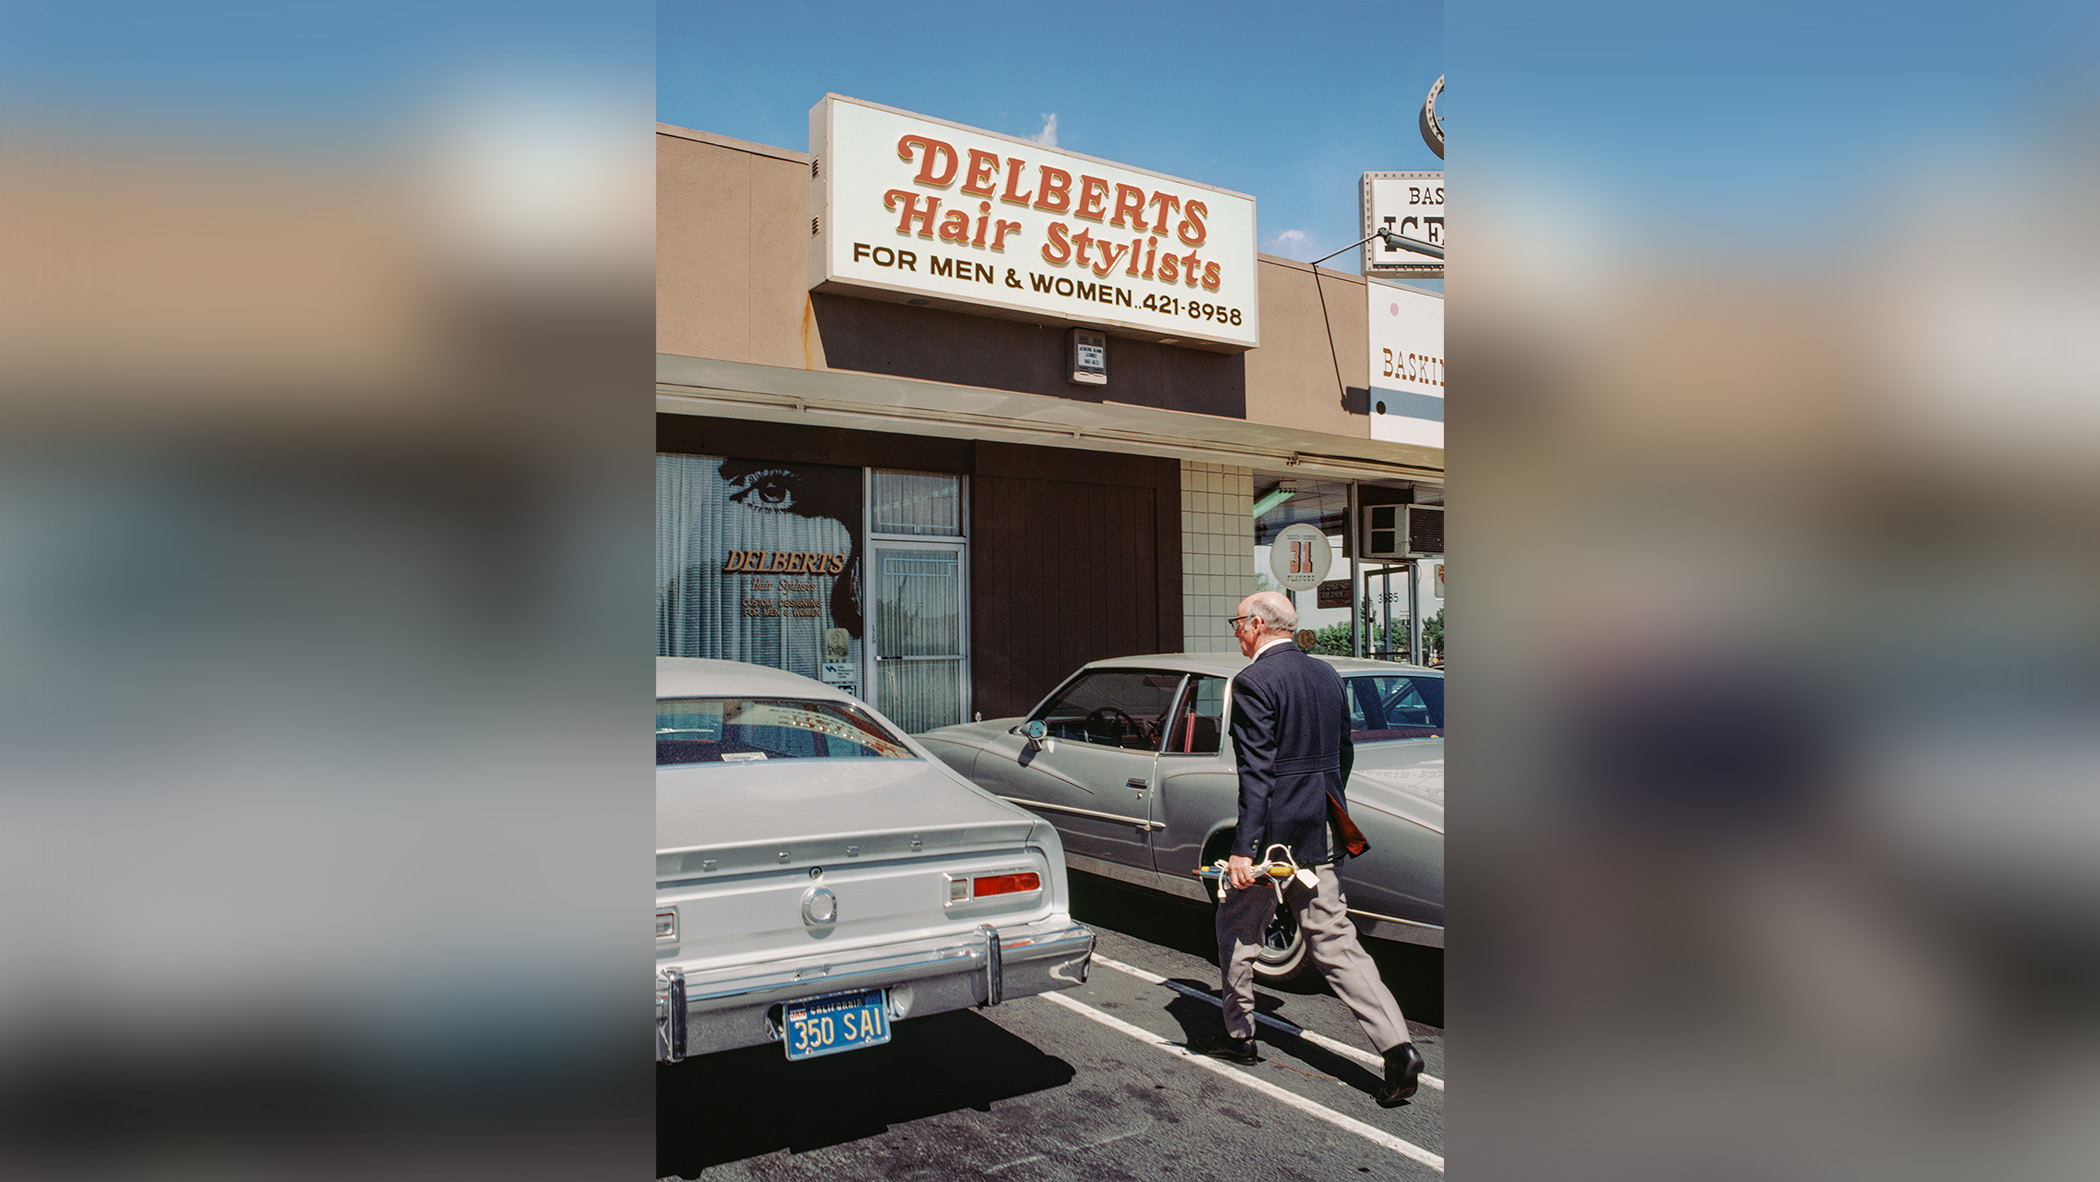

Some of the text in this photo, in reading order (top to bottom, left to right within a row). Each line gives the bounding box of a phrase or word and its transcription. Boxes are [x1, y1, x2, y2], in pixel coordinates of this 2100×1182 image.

[896, 134, 1209, 246] DELBERTS
[883, 188, 1222, 290] Hair Stylists
[853, 242, 918, 272] FOR
[930, 257, 994, 285] MEN
[1005, 268, 1024, 290] &
[723, 550, 845, 575] DELBERTS
[1289, 541, 1313, 573] 31
[751, 578, 816, 595] Hair Stylists
[742, 599, 822, 609] CUSTOM DESIGNING
[744, 608, 760, 618] FOR
[763, 608, 781, 618] MEN
[793, 608, 821, 618] WOMEN
[790, 1010, 807, 1019] JAN
[810, 998, 863, 1016] CALIFORNIA
[794, 1007, 882, 1051] 350 SAI
